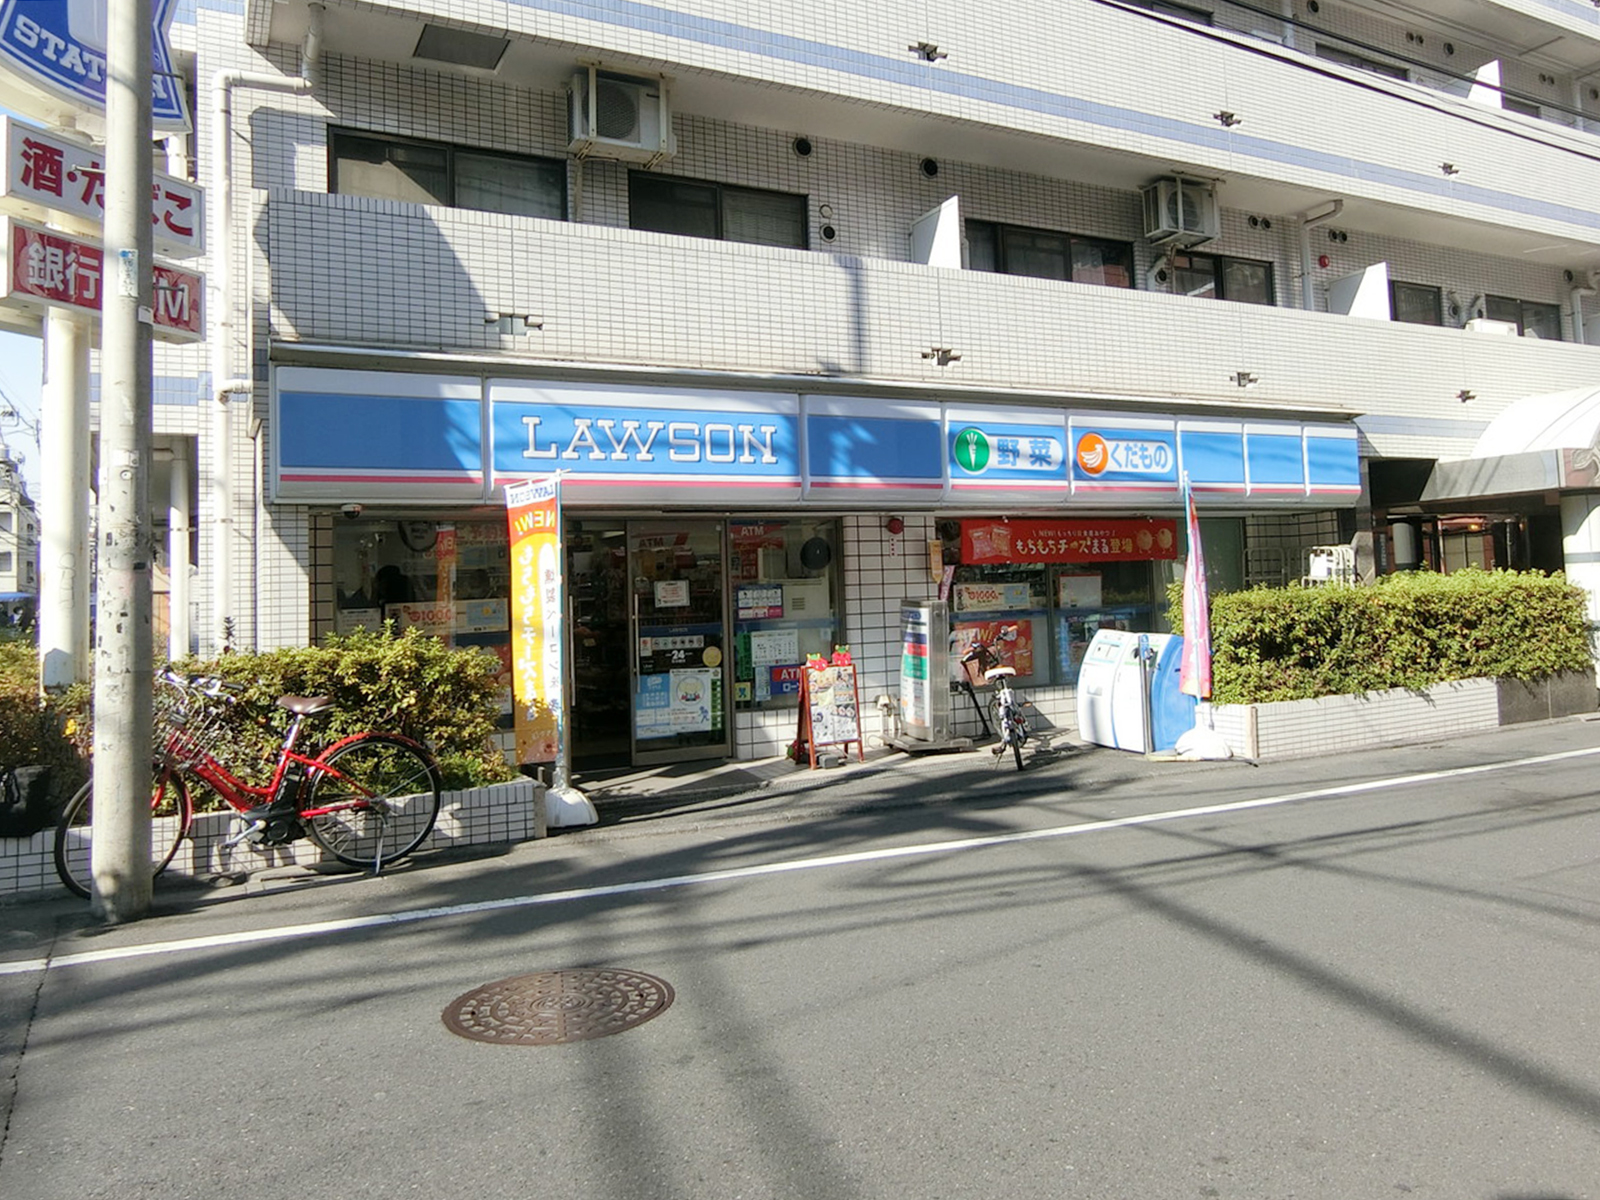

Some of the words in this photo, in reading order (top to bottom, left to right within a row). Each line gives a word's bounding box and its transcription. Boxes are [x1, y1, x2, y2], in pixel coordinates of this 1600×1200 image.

[13, 14, 168, 99] STATN
[20, 136, 193, 237] 酒・たこ
[521, 416, 778, 464] LAWSON
[997, 437, 1053, 467] 野菜
[1110, 442, 1168, 470] くだもの
[639, 537, 664, 547] ATM
[740, 525, 764, 536] ATM
[1016, 537, 1133, 555] もちもちチーズまる登場
[671, 650, 686, 659] 24
[783, 682, 800, 692] ロー
